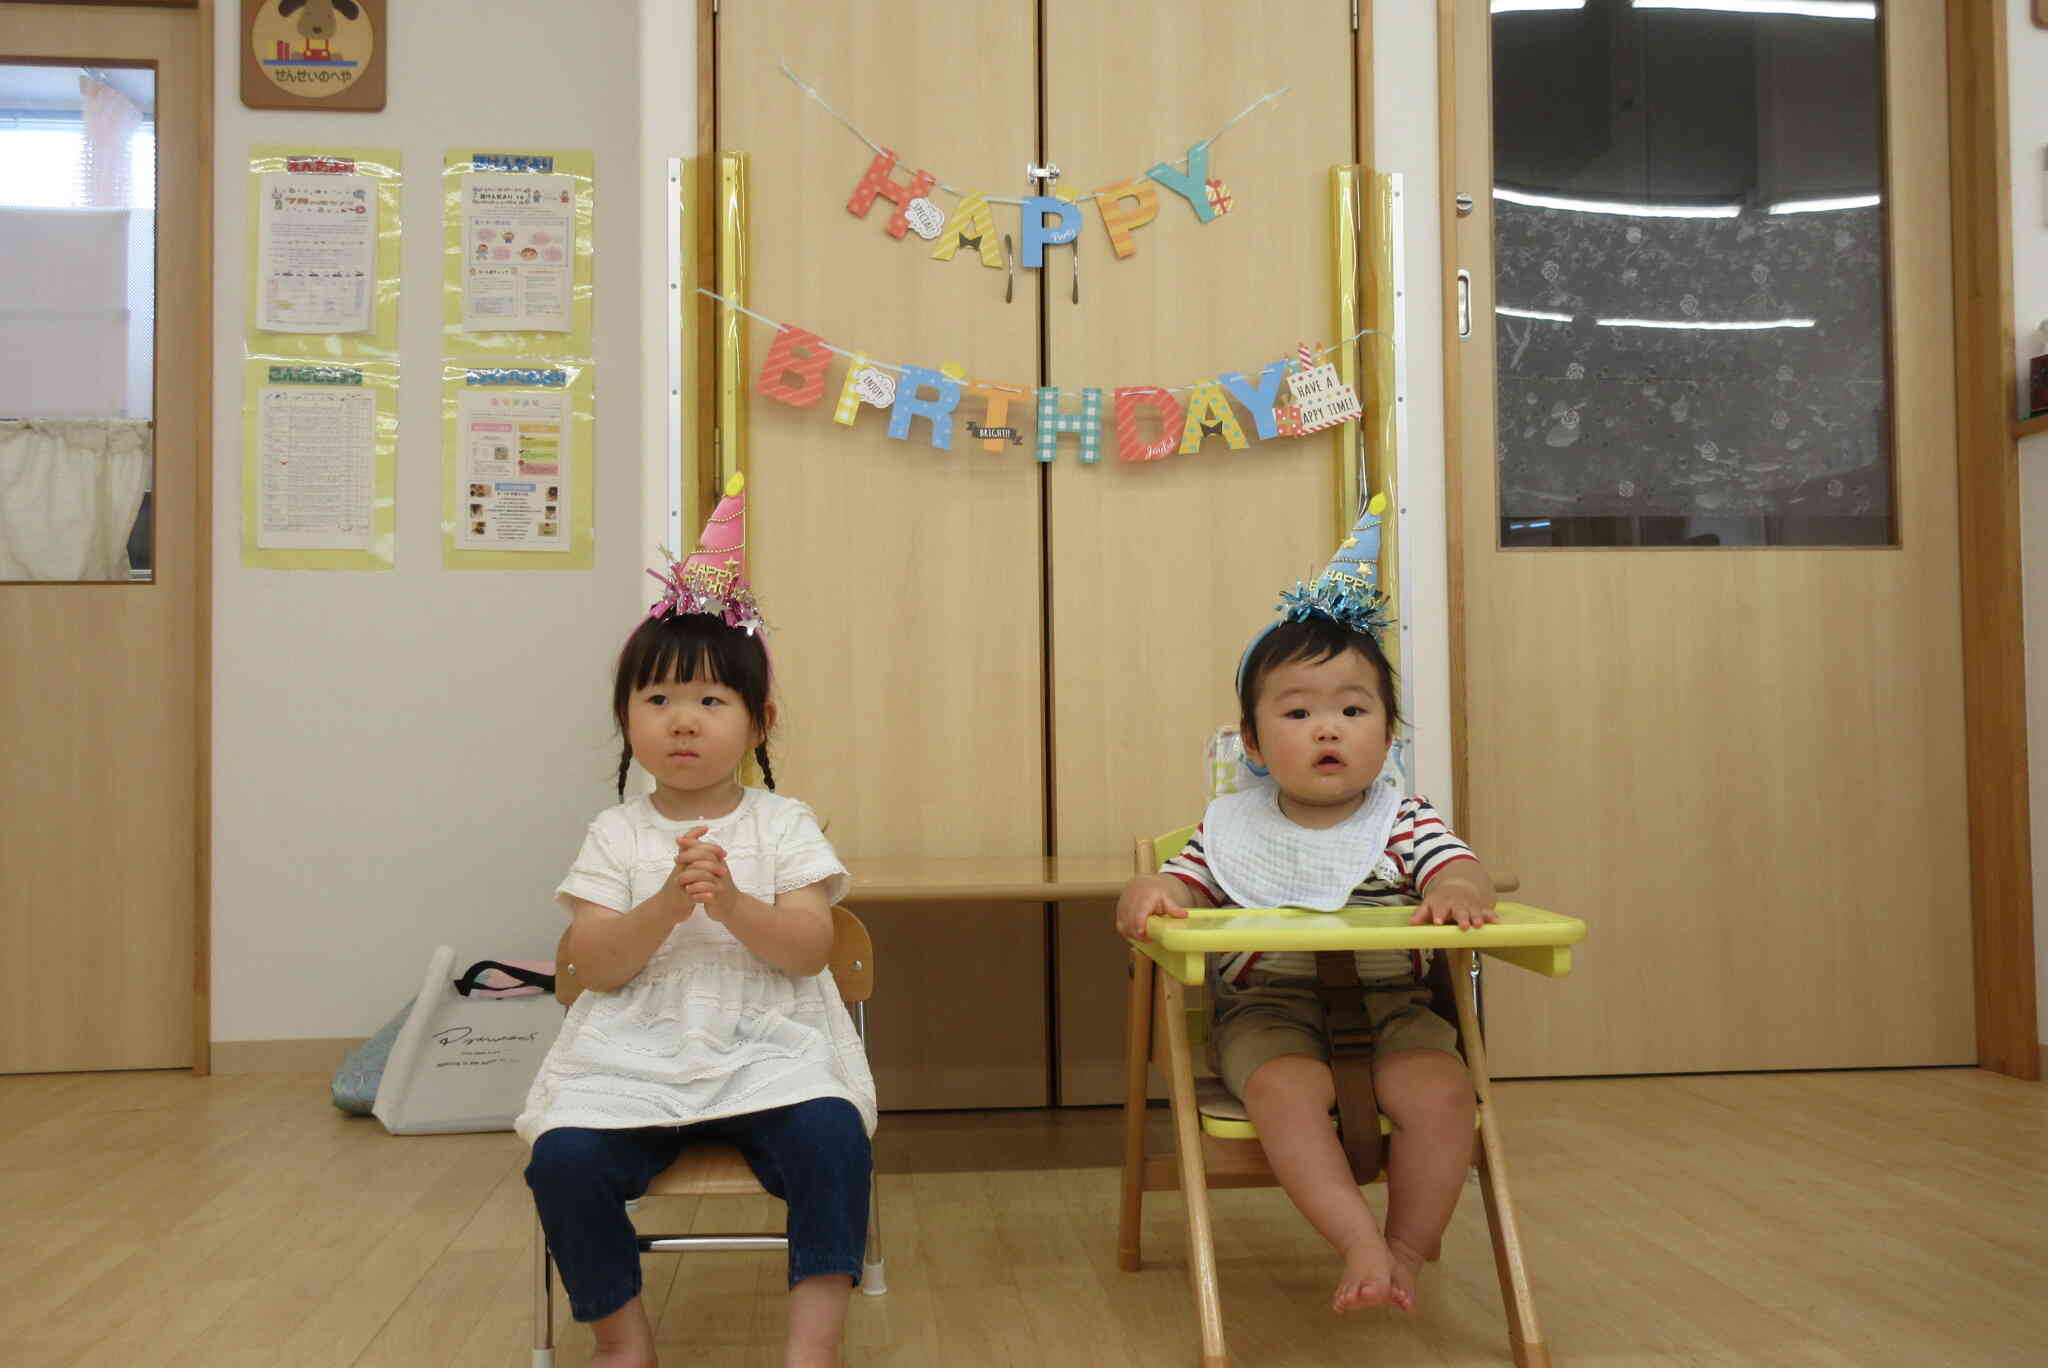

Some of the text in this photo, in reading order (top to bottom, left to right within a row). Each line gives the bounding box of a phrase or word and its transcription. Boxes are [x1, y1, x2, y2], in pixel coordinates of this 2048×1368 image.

[275, 69, 352, 83] せんせいのへや
[847, 140, 1228, 269] HAPPY
[757, 322, 1289, 463] BIRTHDAY
[1296, 375, 1334, 398] HAVE A
[1303, 407, 1325, 425] APPY
